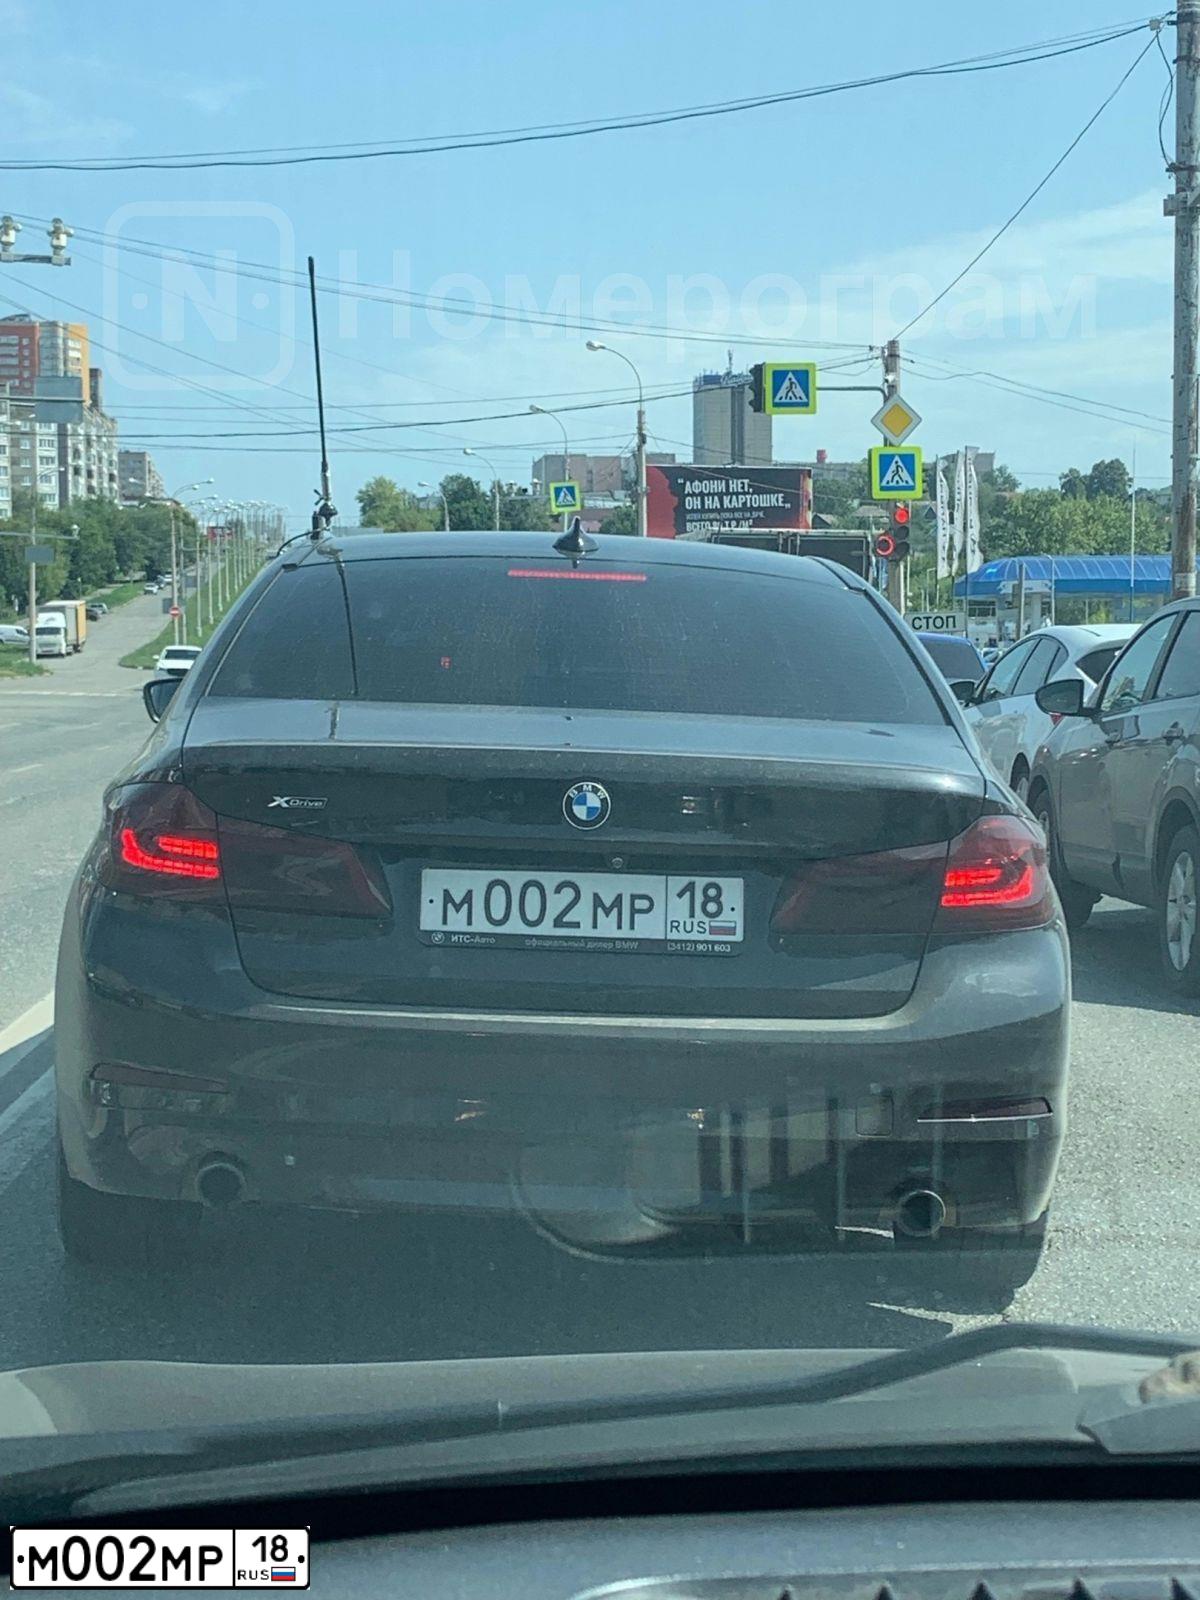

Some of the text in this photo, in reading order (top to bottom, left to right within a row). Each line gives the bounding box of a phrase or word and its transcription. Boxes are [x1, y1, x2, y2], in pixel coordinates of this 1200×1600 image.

[685, 496, 700, 509] ОН
[704, 496, 721, 509] НА
[911, 615, 957, 630] СТОП
[568, 784, 606, 799] BMW
[441, 879, 723, 931] М002МР 18
[669, 919, 707, 935] RUS
[451, 935, 496, 945] ИТС-Авто
